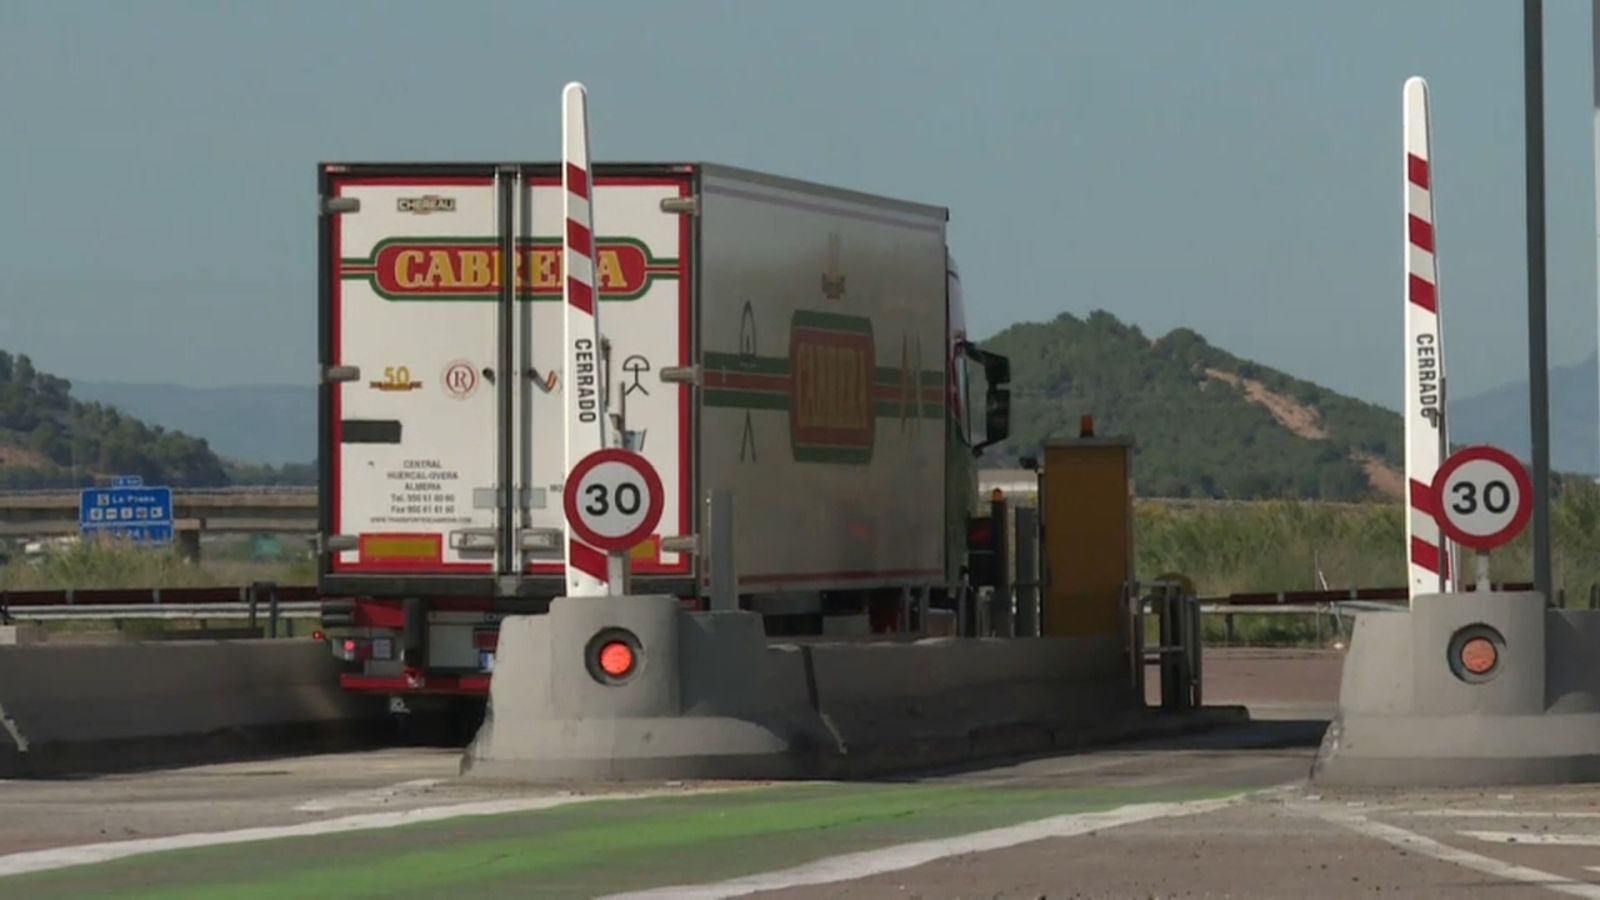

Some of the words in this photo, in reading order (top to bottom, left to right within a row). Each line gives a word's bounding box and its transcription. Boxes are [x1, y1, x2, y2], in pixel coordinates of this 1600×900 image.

[383, 366, 410, 385] 50
[574, 338, 596, 423] CERRADO
[1416, 333, 1439, 419] CERRADO
[403, 459, 442, 469] CENTRAL
[391, 504, 405, 513] Fax
[585, 482, 641, 516] 30
[1452, 480, 1511, 516] 30
